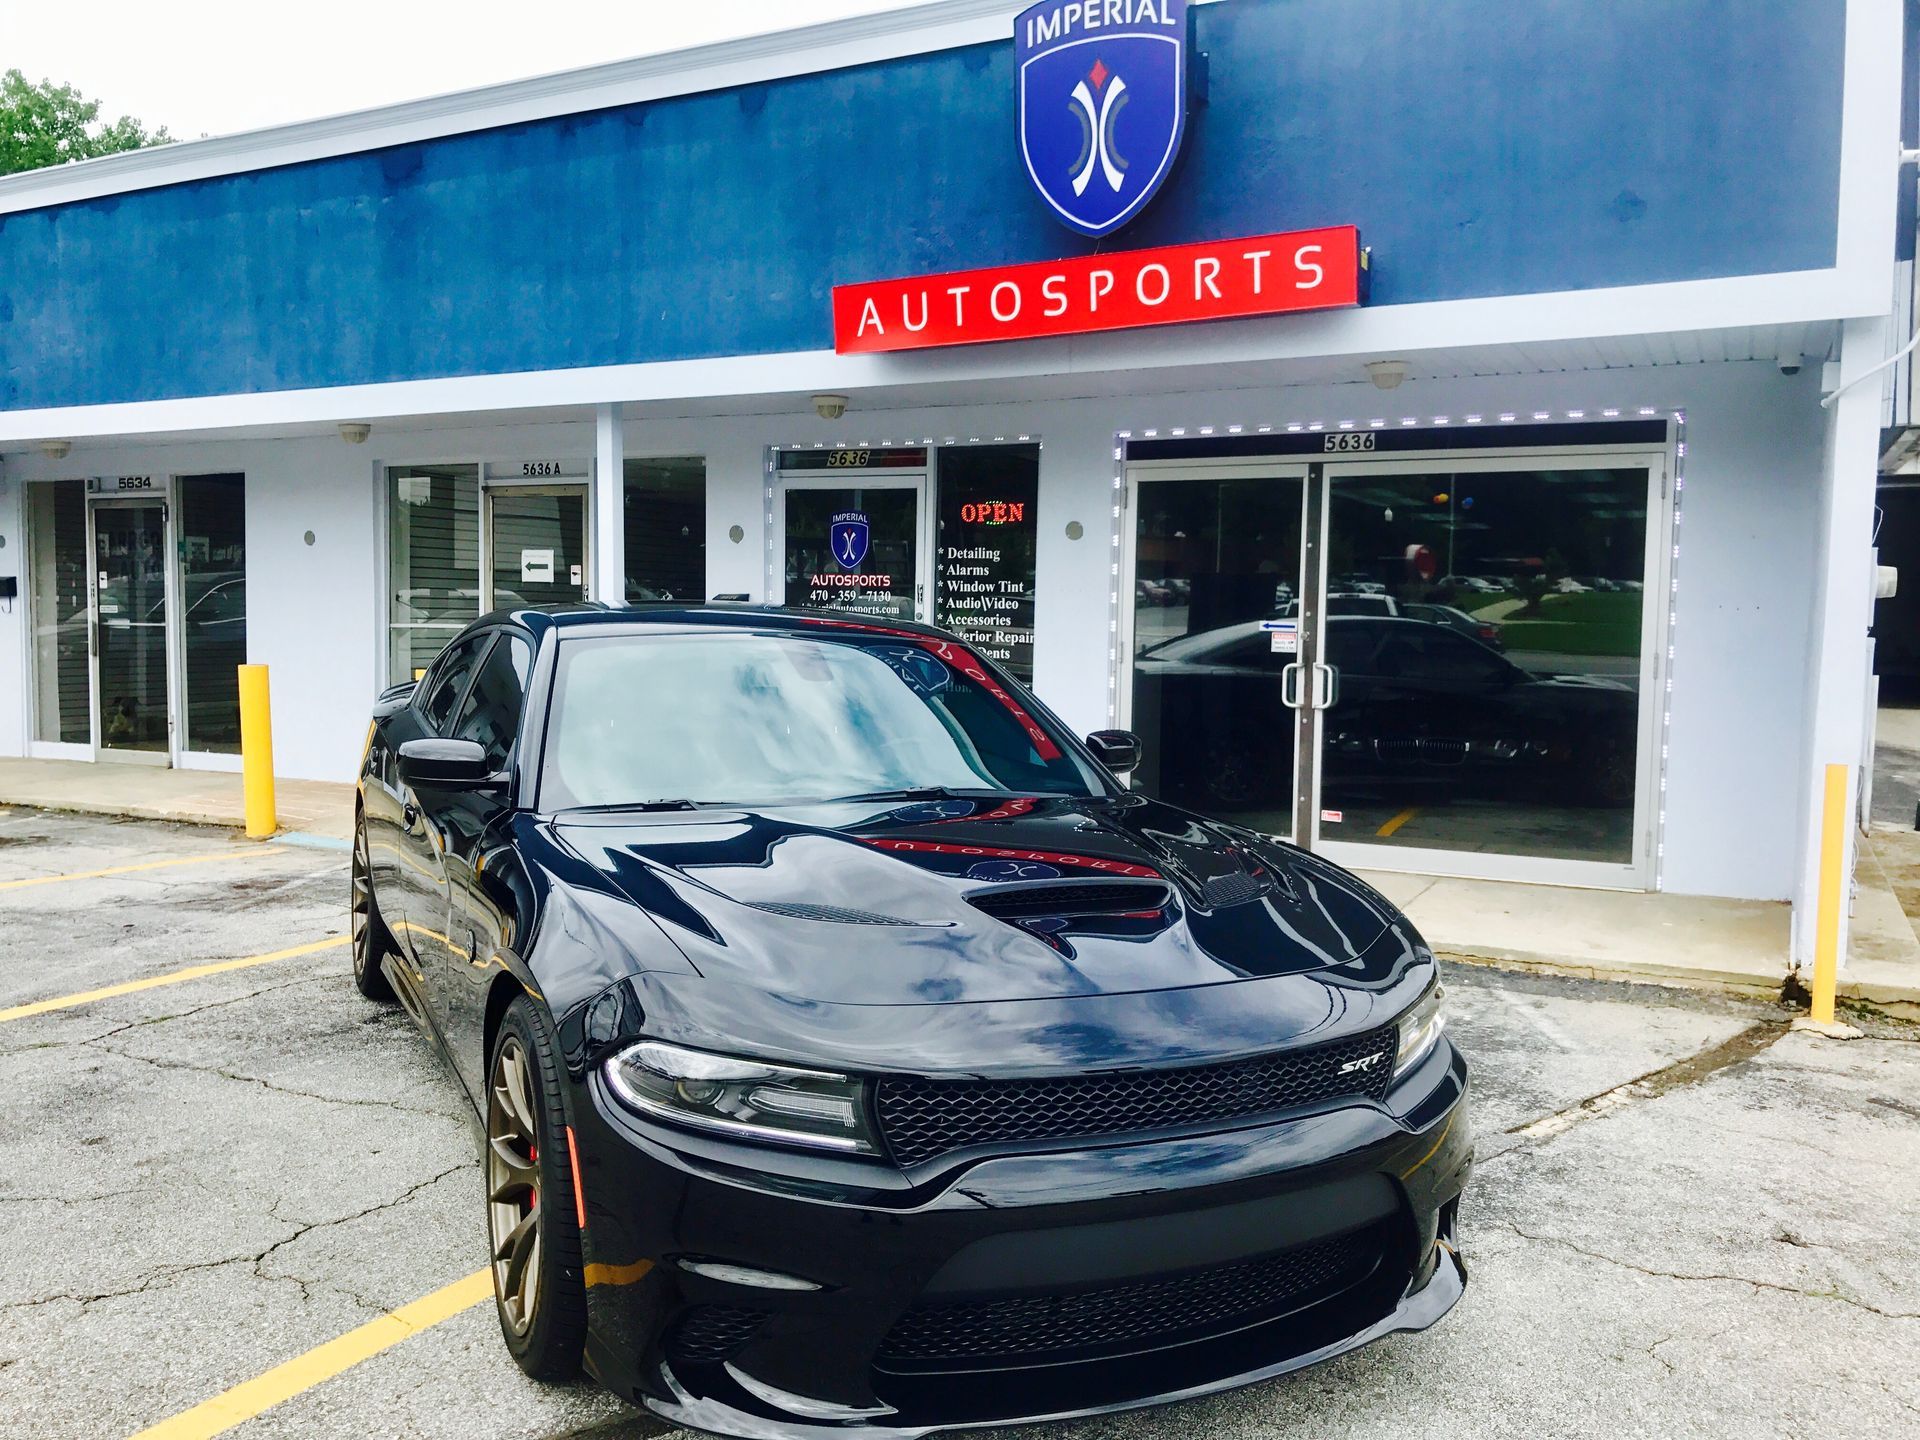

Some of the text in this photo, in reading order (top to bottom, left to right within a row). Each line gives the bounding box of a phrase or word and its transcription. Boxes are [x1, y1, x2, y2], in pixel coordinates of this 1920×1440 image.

[1027, 0, 1176, 49] IMPERIAL
[856, 244, 1324, 338] AUTOSPORTS
[1325, 433, 1374, 451] 5636
[829, 451, 869, 466] 5636
[523, 462, 561, 476] 5636 A
[118, 476, 152, 489] 5634
[832, 512, 868, 523] IMPERIAL
[961, 503, 1025, 522] OPEN
[947, 547, 1001, 563] Detailing
[946, 563, 990, 576] Alarms
[810, 574, 891, 587] AUTOSPORTS
[946, 580, 1025, 593] Window Tint
[810, 590, 829, 601] 470
[838, 590, 857, 602] 359
[866, 590, 891, 602] 7130
[945, 595, 1019, 612] Audio\Video
[945, 613, 1012, 626] Accessories
[948, 630, 993, 642] terior
[1336, 1051, 1384, 1075] SRT
